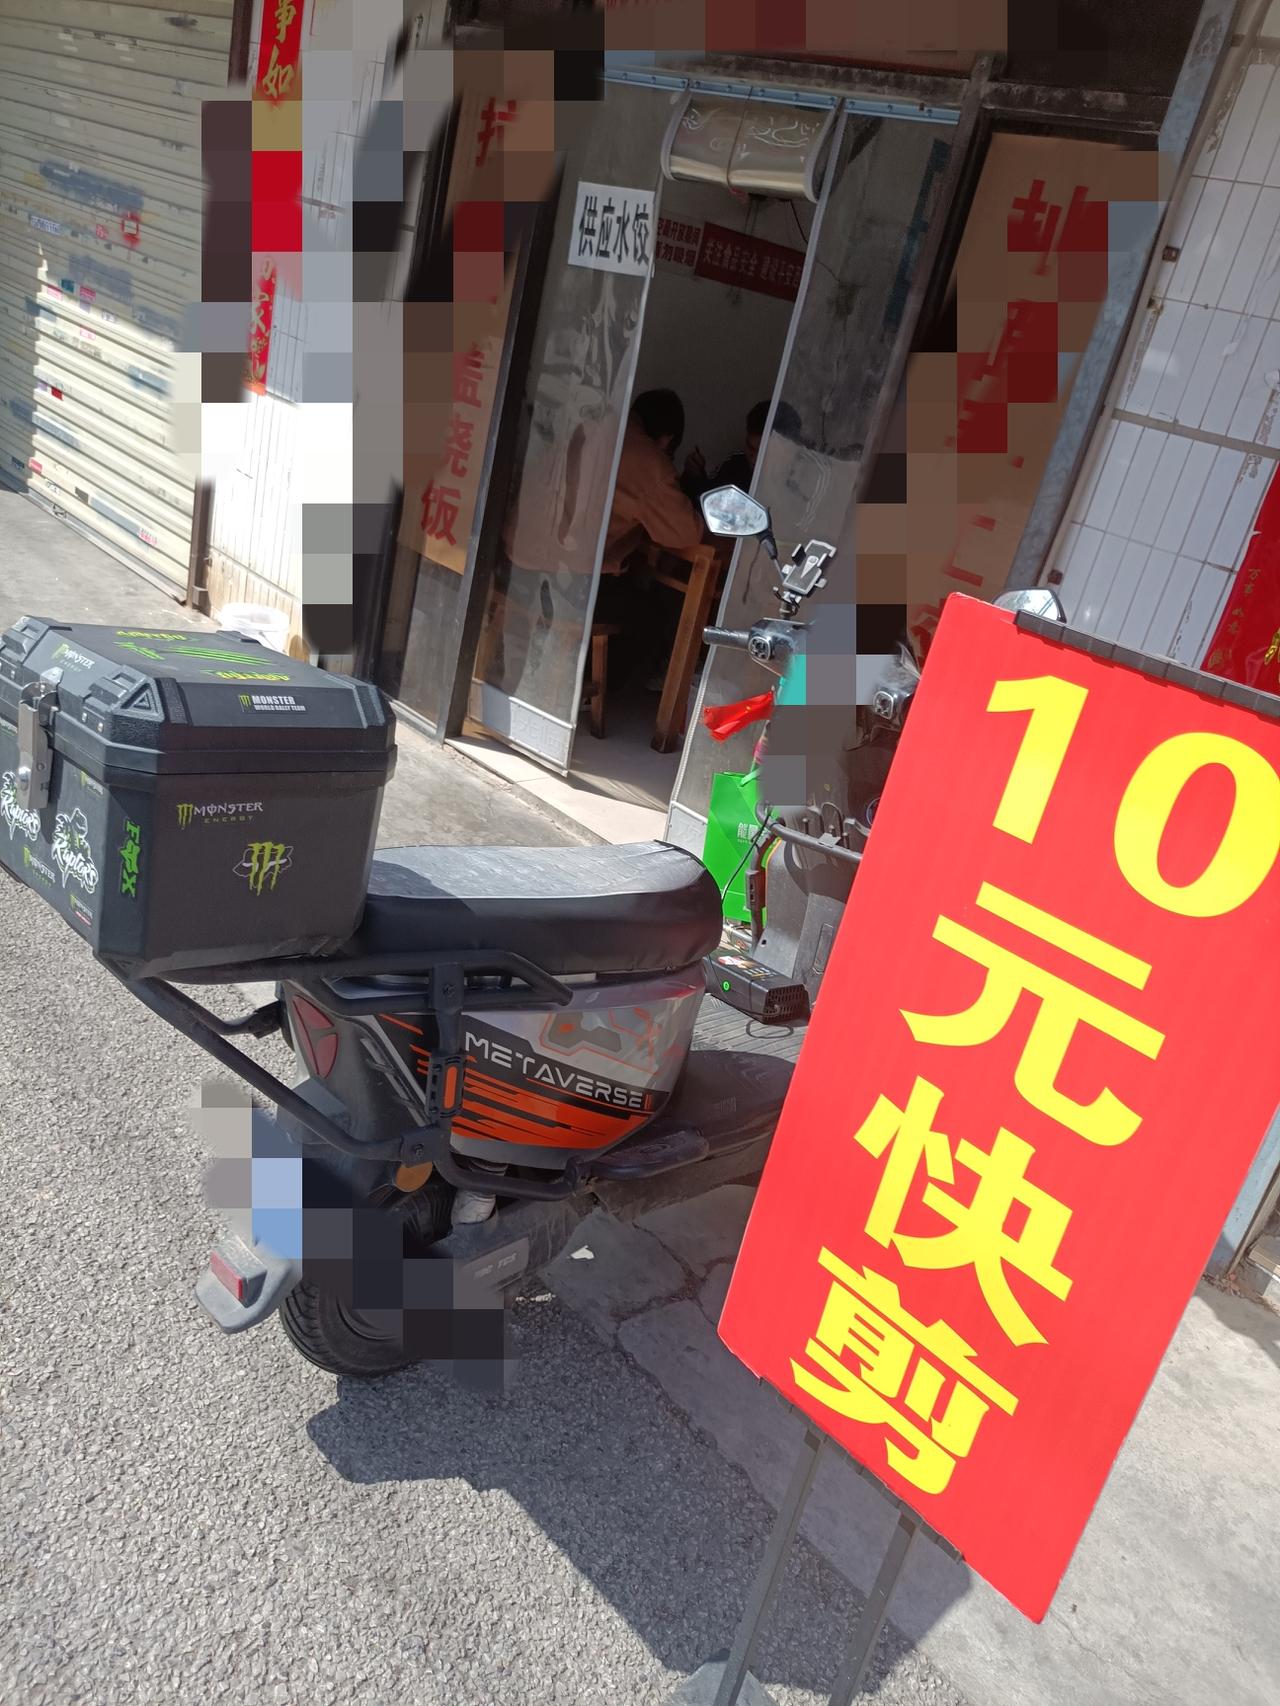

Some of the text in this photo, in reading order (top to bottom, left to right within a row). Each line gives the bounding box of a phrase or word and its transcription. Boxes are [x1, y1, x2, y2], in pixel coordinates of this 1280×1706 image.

[578, 195, 650, 266] 供应水饺
[252, 695, 296, 705] MONSTER
[194, 802, 264, 817] MONSTER
[465, 1031, 643, 1108] METAVERSE
[792, 677, 1280, 1493] 10元快剪
